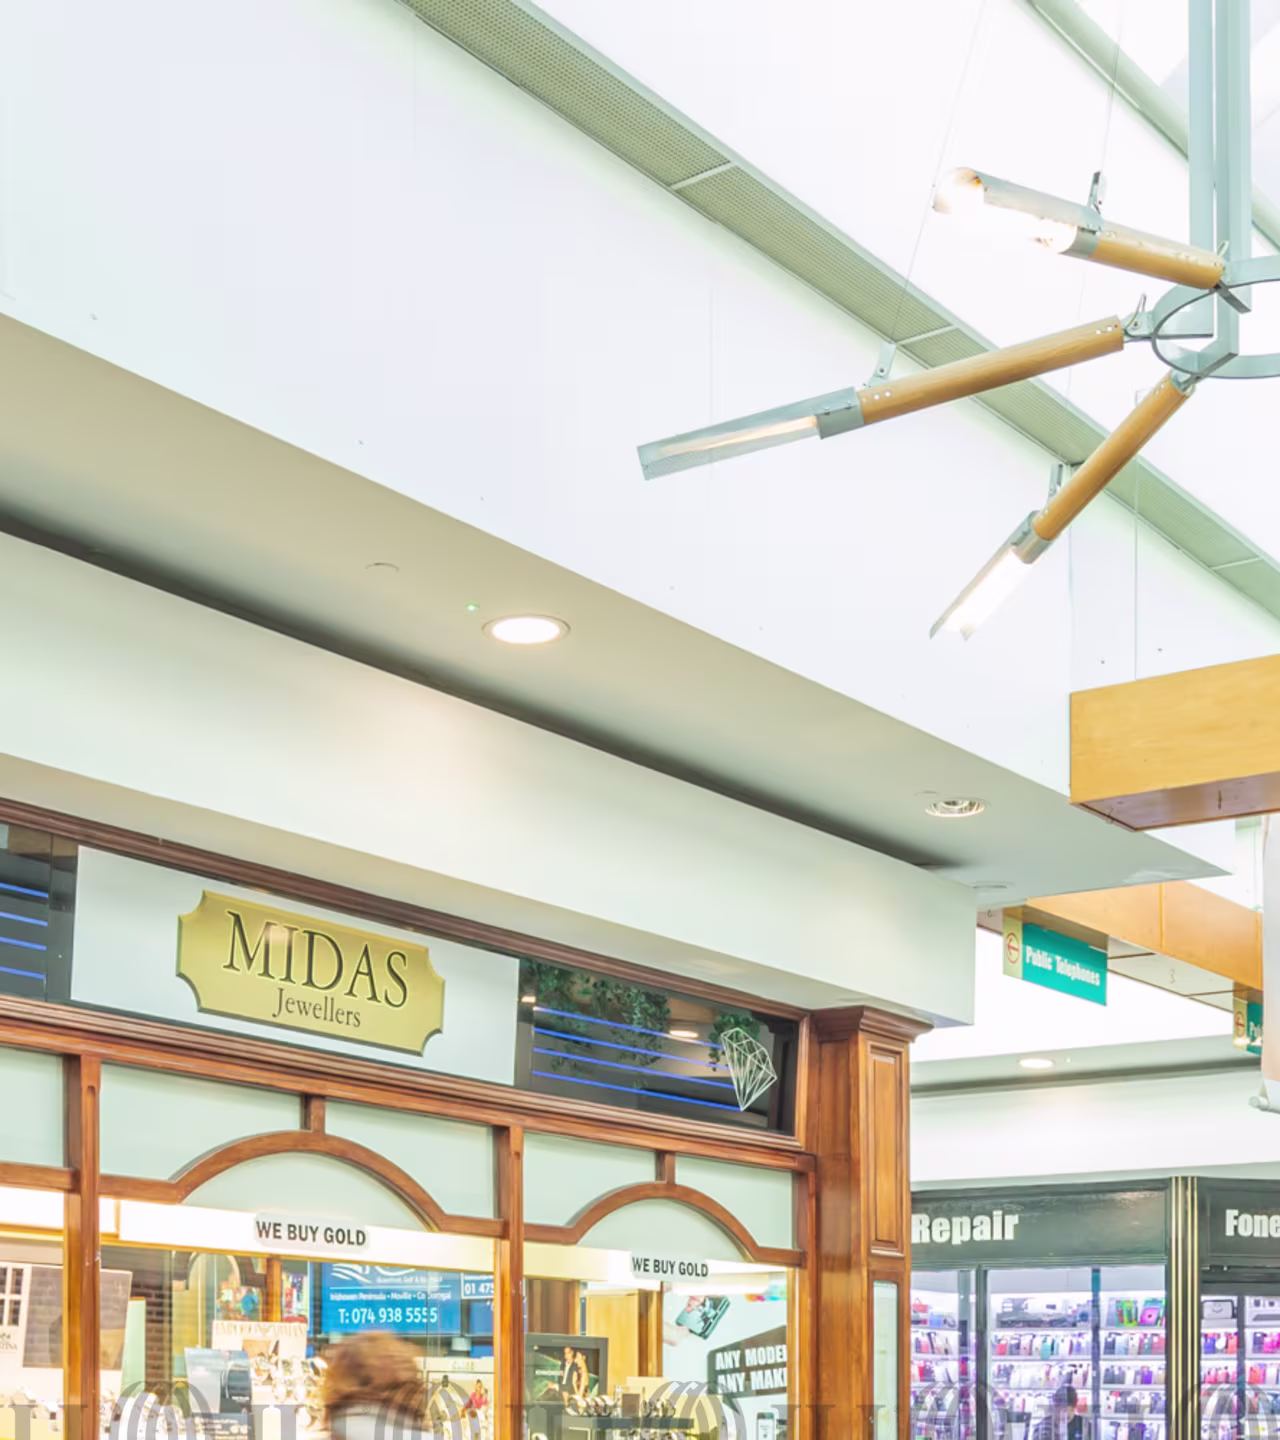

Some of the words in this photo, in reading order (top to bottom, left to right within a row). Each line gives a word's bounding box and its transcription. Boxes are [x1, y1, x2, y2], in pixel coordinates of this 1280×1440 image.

[223, 910, 408, 1008] MIDAS
[1025, 945, 1053, 971] Public
[1055, 956, 1100, 986] Telephones
[272, 987, 361, 1028] Jewellers
[256, 1221, 282, 1240] WE
[287, 1223, 319, 1242] BUY
[324, 1227, 366, 1246] GOLD
[911, 1210, 1019, 1245] Repair
[632, 1257, 650, 1272] WE
[653, 1259, 676, 1275] BUY
[678, 1261, 709, 1277] GOLD
[464, 1282, 476, 1295] 01
[338, 1308, 349, 1323] T:
[351, 1308, 375, 1324] 074
[379, 1307, 402, 1323] 938
[405, 1307, 438, 1323] 5555
[715, 1350, 741, 1371] ANY
[717, 1372, 745, 1394] ANY
